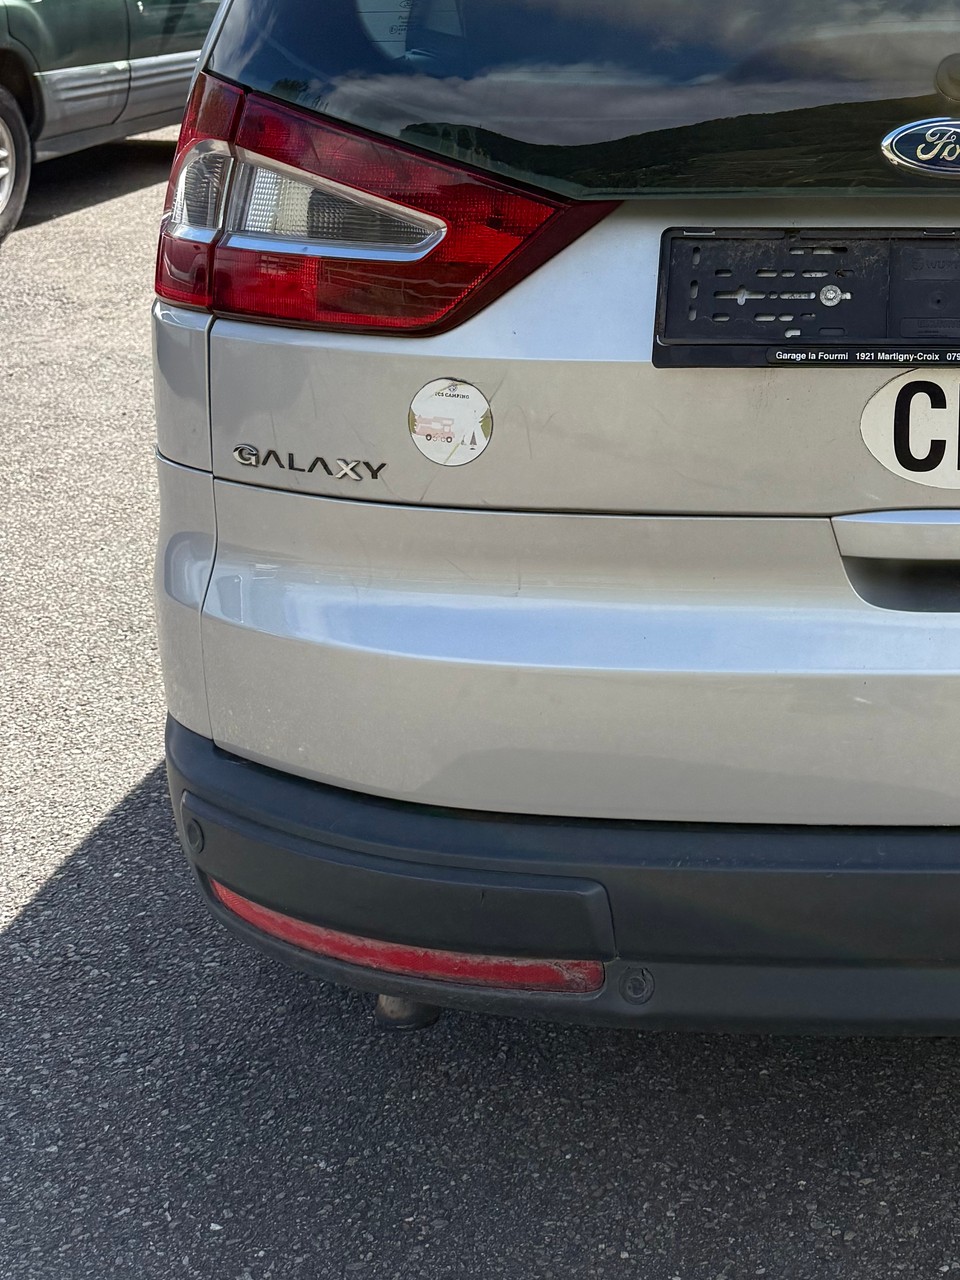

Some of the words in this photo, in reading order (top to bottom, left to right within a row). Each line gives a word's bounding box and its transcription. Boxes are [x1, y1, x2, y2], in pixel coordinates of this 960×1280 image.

[775, 351, 807, 361] Garage
[808, 352, 816, 360] la
[818, 352, 849, 360] Fourmi
[855, 352, 875, 360] 1921
[877, 352, 940, 362] Martigny-Croix
[232, 443, 387, 481] GALAXY
